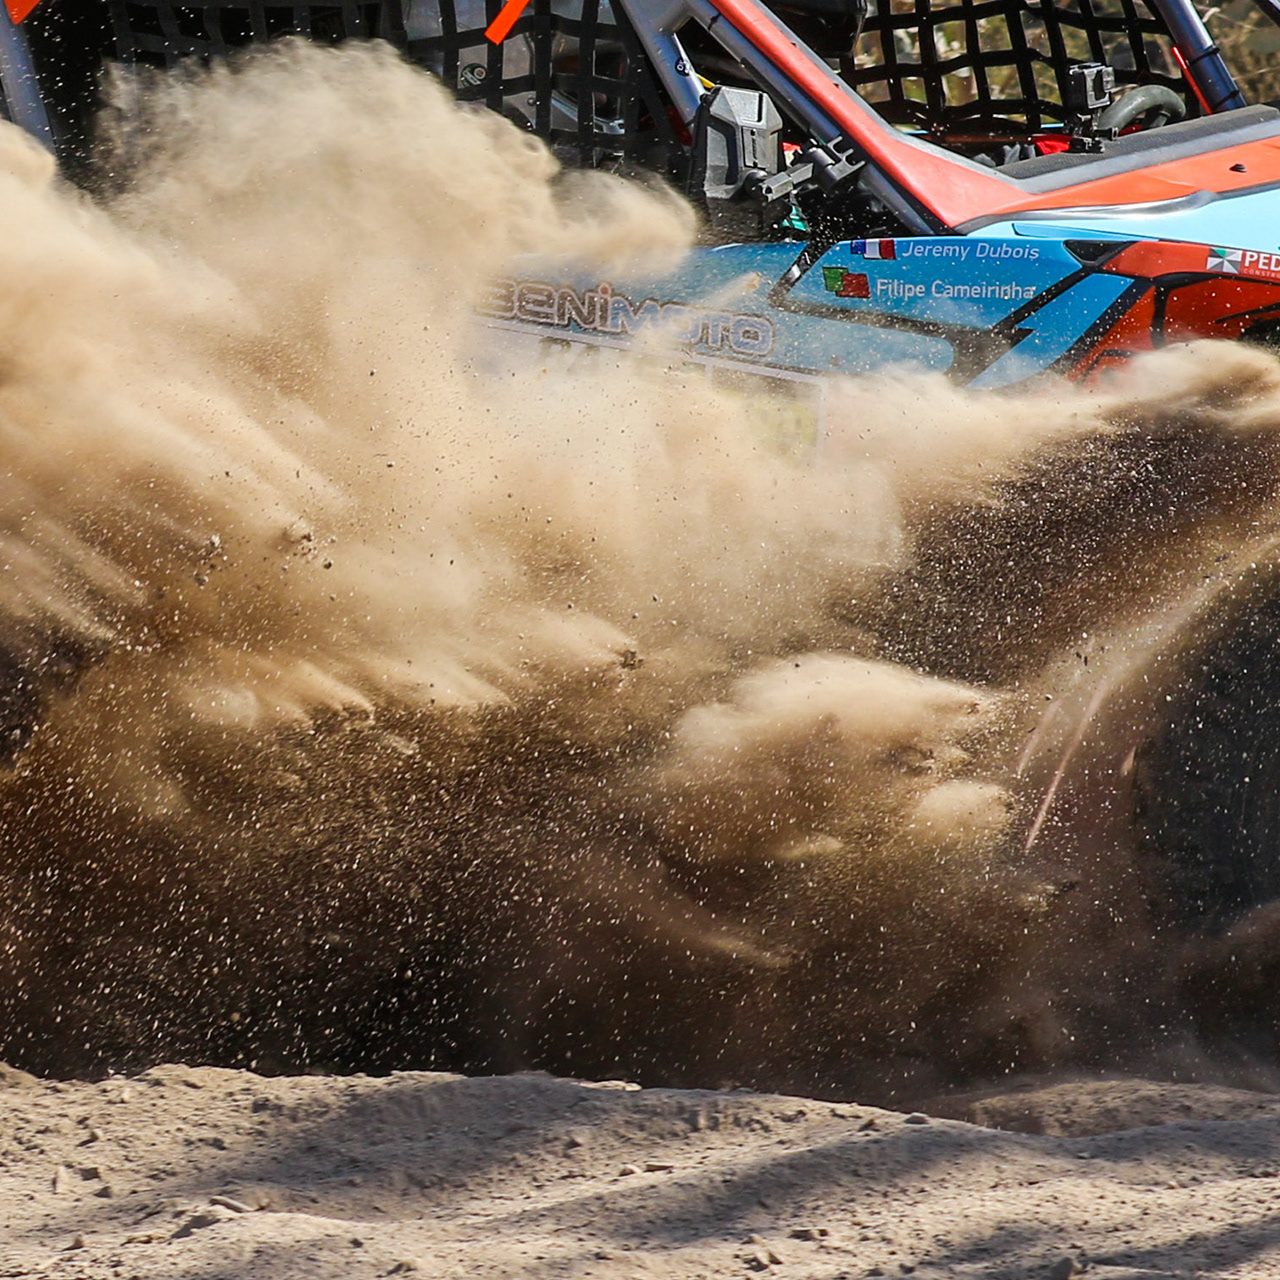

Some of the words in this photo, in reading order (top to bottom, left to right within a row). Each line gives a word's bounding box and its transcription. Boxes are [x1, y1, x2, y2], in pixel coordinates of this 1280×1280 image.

[902, 241, 970, 261] Jeremy
[975, 243, 1040, 260] Dubois
[876, 278, 926, 300] Filipe
[931, 280, 1035, 300] Cameirinha
